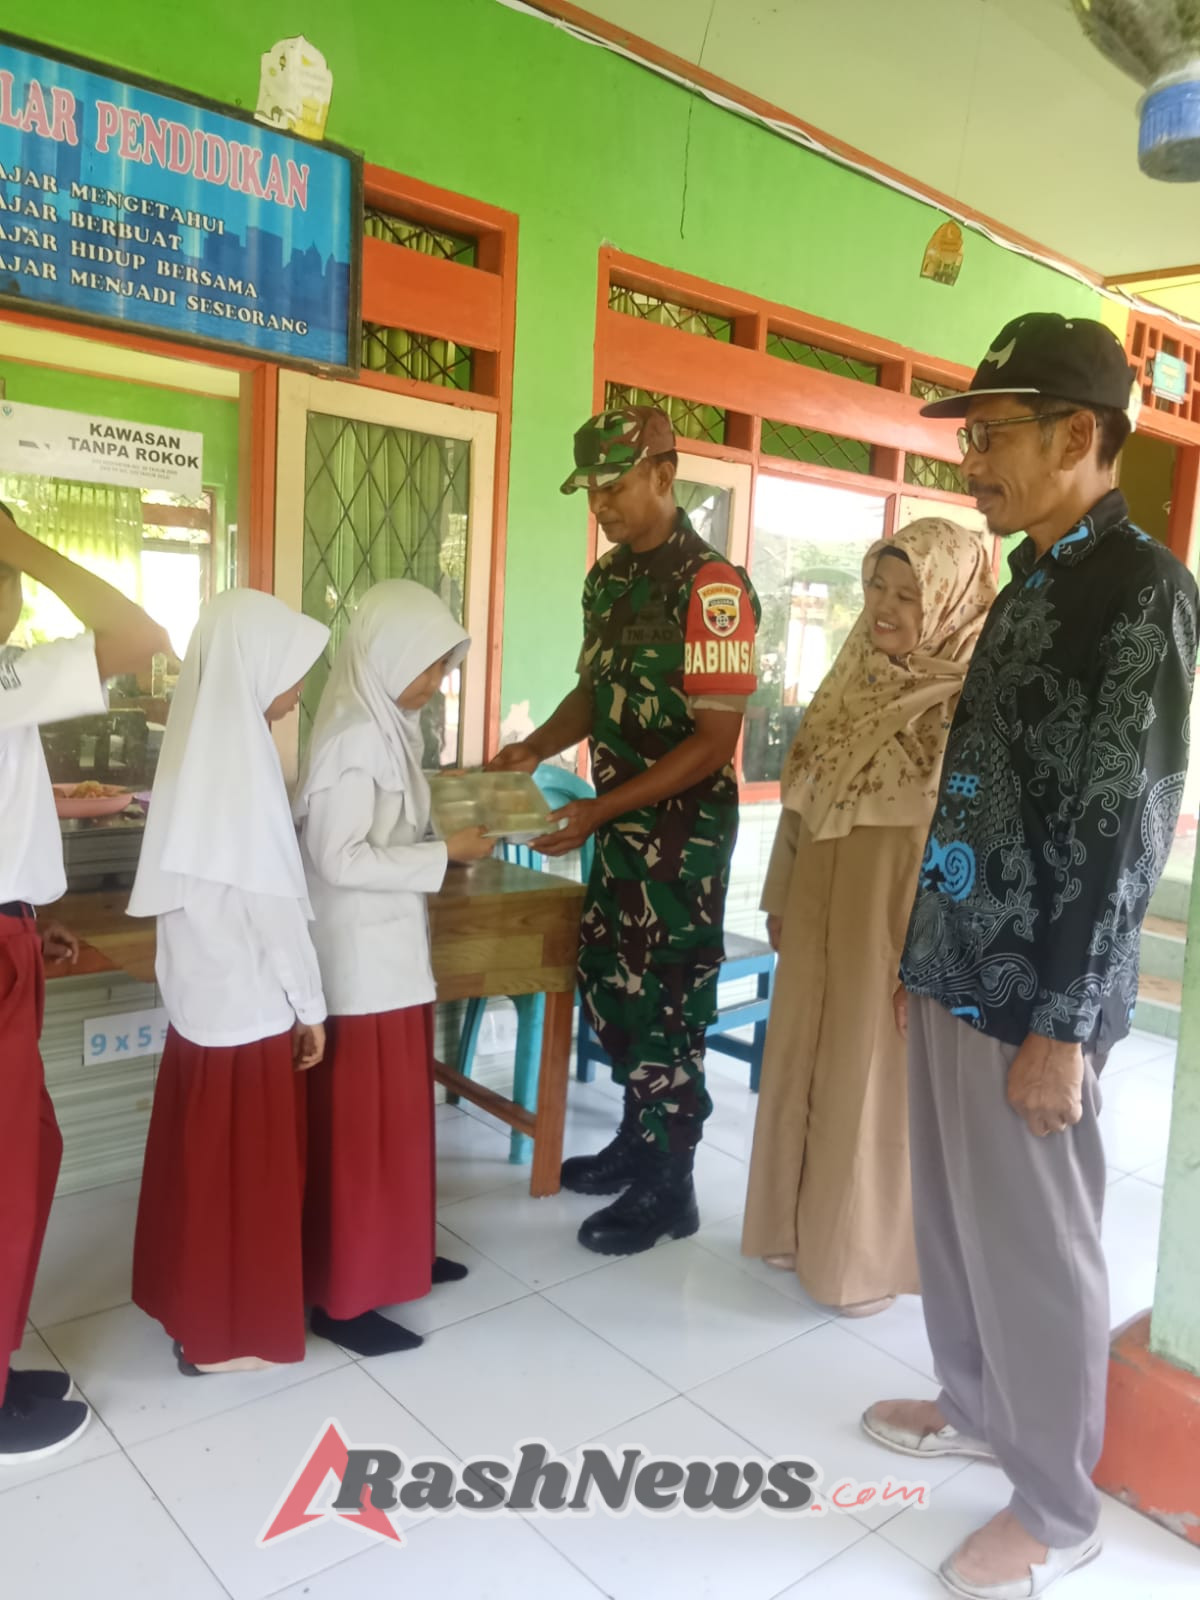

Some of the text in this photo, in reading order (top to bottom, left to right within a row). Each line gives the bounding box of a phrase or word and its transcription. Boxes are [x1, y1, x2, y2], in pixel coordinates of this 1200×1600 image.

[96, 101, 309, 211] PENDIDIKAN
[71, 181, 225, 235] MENGETAHUI
[71, 211, 183, 250] BERBUAT
[71, 240, 145, 270] HIDUP
[157, 260, 257, 298] BERSAMA
[71, 269, 176, 306] MENJADI
[186, 295, 308, 335] SESEORANG
[68, 436, 129, 458] TANPA
[135, 448, 199, 469] ROKOK
[89, 422, 181, 449] KAWASAN
[90, 1033, 107, 1056] 9
[138, 1025, 152, 1048] 5
